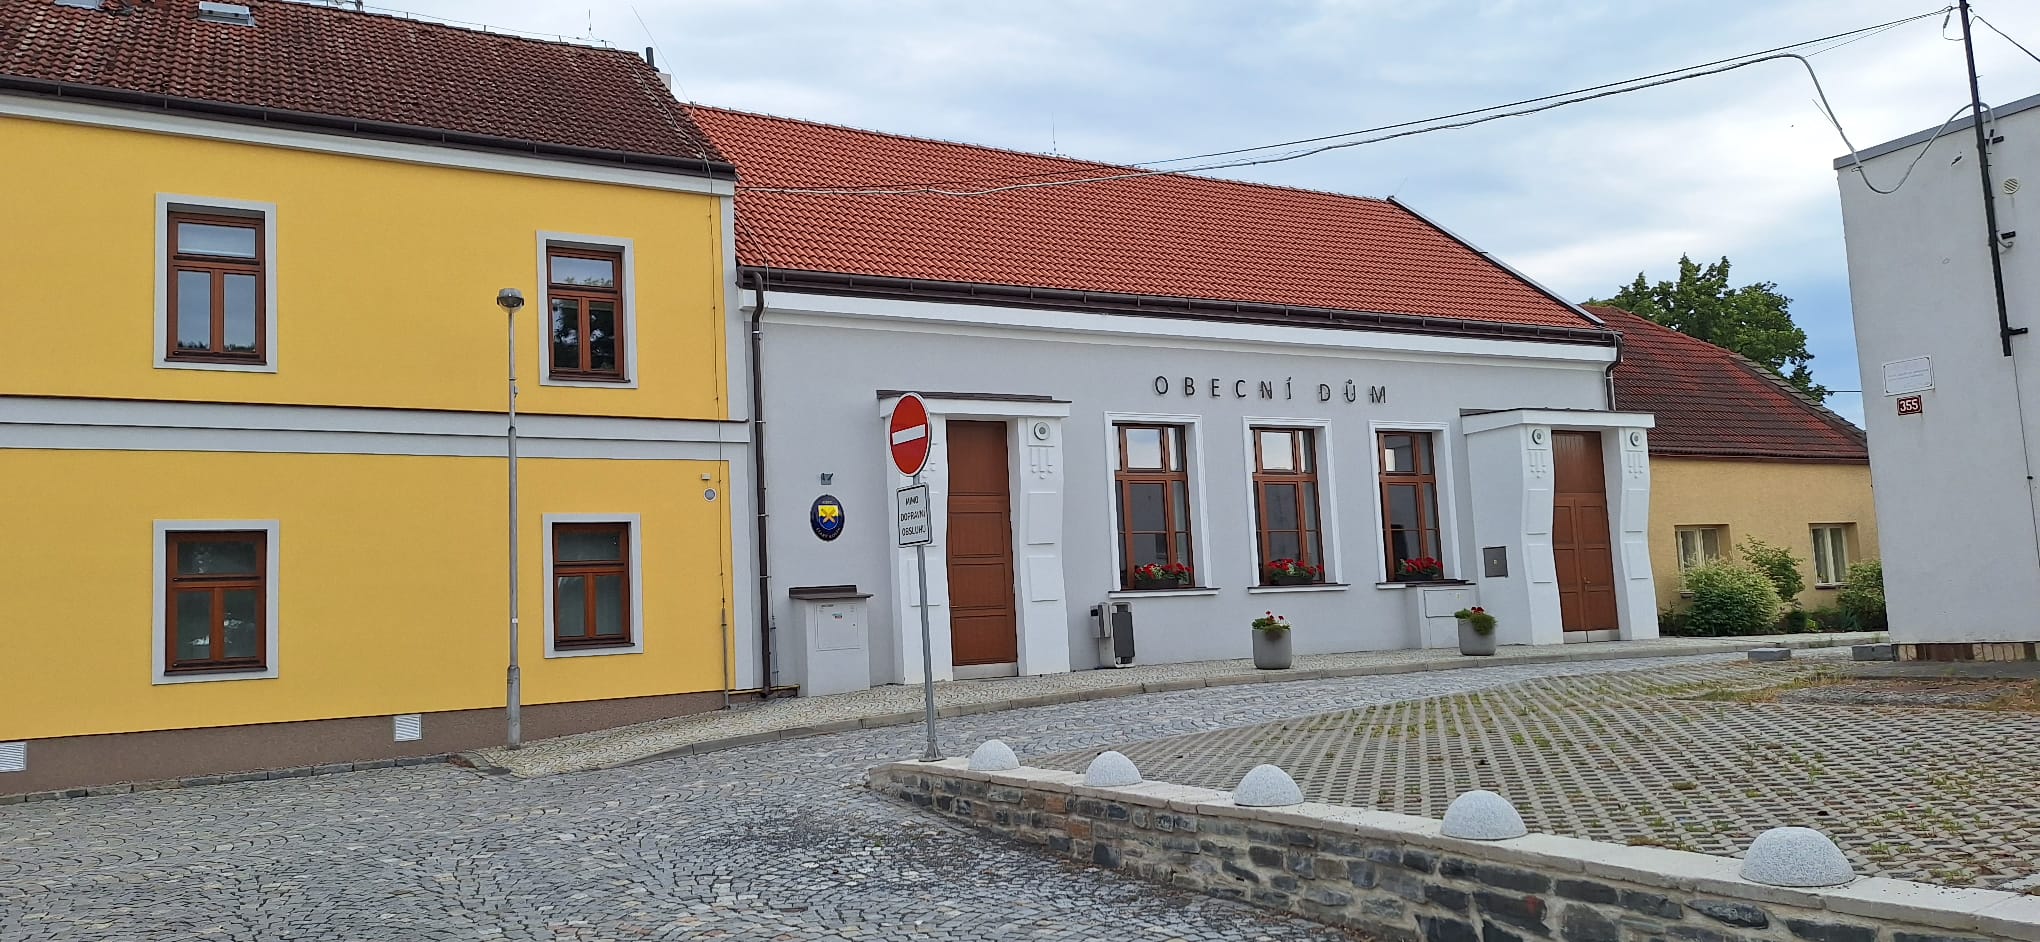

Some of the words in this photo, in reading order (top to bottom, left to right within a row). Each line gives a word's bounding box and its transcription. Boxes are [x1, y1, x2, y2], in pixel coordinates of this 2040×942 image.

[1155, 376, 1292, 400] OBECNÍ
[1319, 379, 1387, 403] DŮM
[1900, 399, 1919, 411] 355
